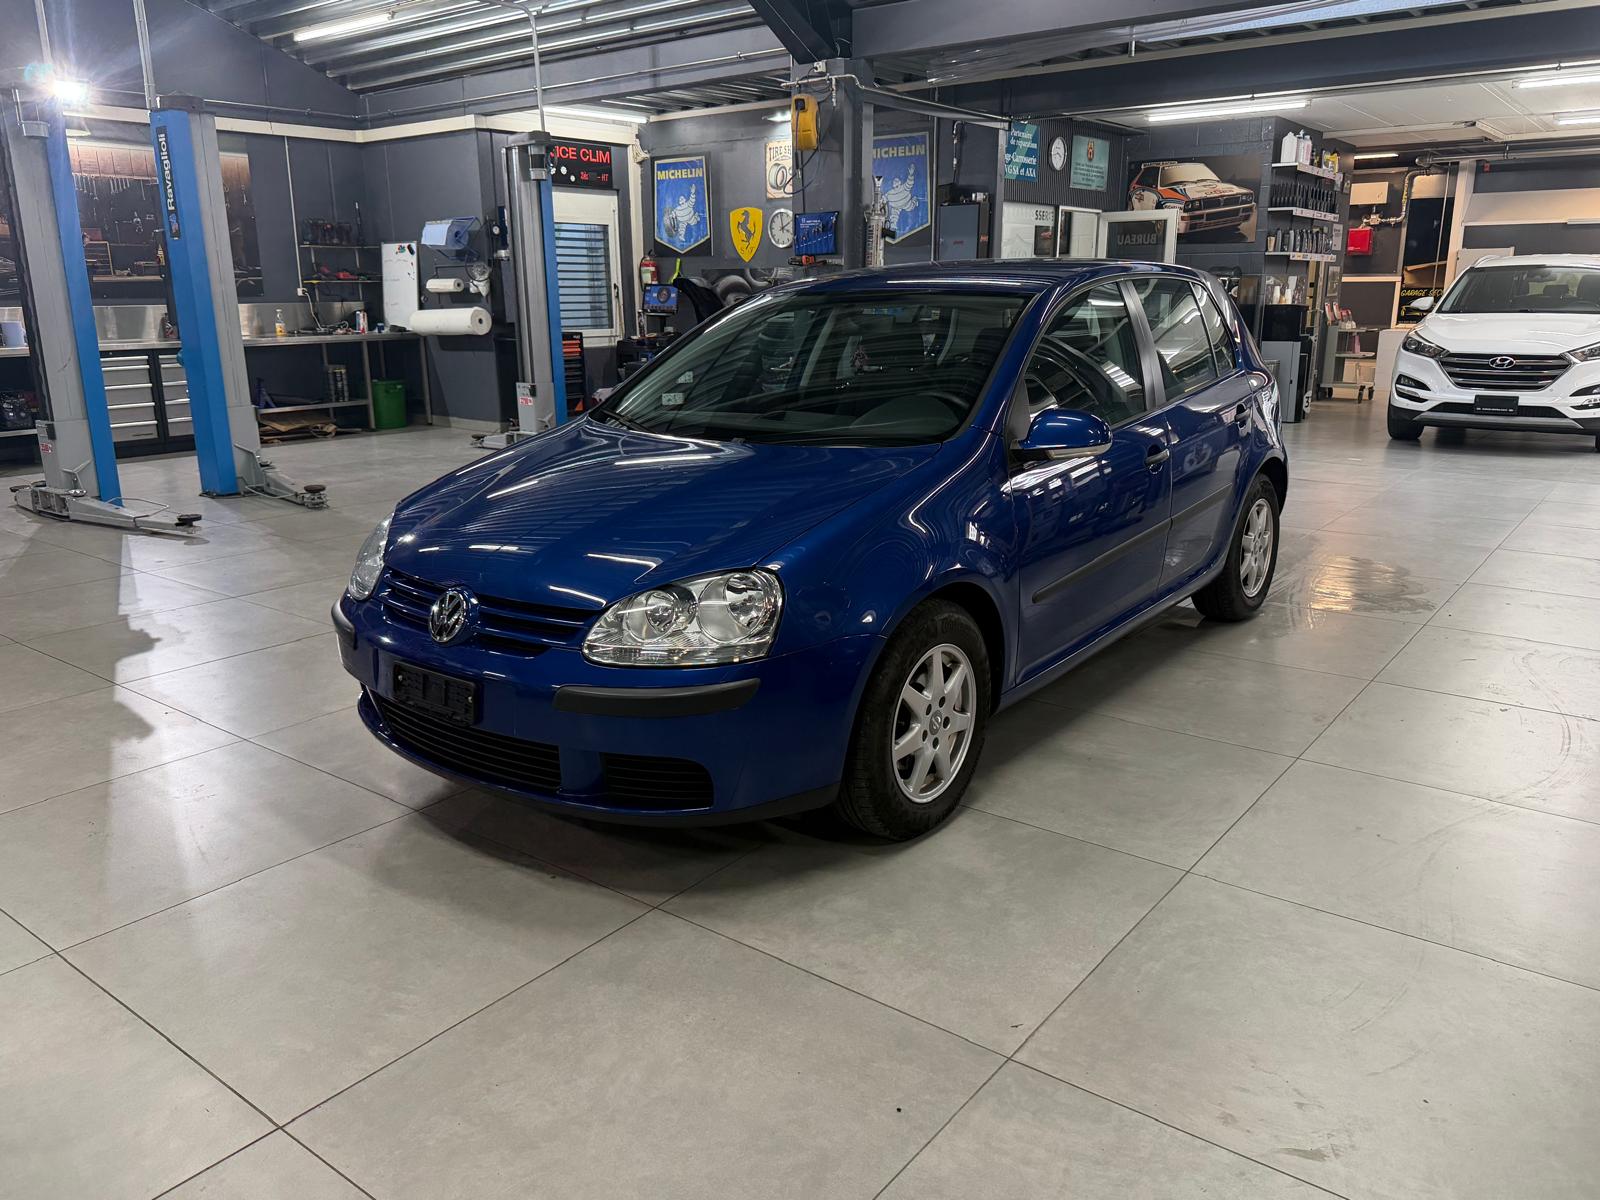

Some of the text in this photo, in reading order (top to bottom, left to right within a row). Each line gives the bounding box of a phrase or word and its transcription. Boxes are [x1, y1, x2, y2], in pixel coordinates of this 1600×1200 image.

[550, 145, 610, 163] ICE CLIM
[769, 145, 783, 161] TIRE
[158, 133, 175, 211] Ravaglioli
[657, 167, 703, 180] MICHELIN
[1025, 167, 1036, 178] AXA
[1401, 289, 1428, 297] GARAGE
